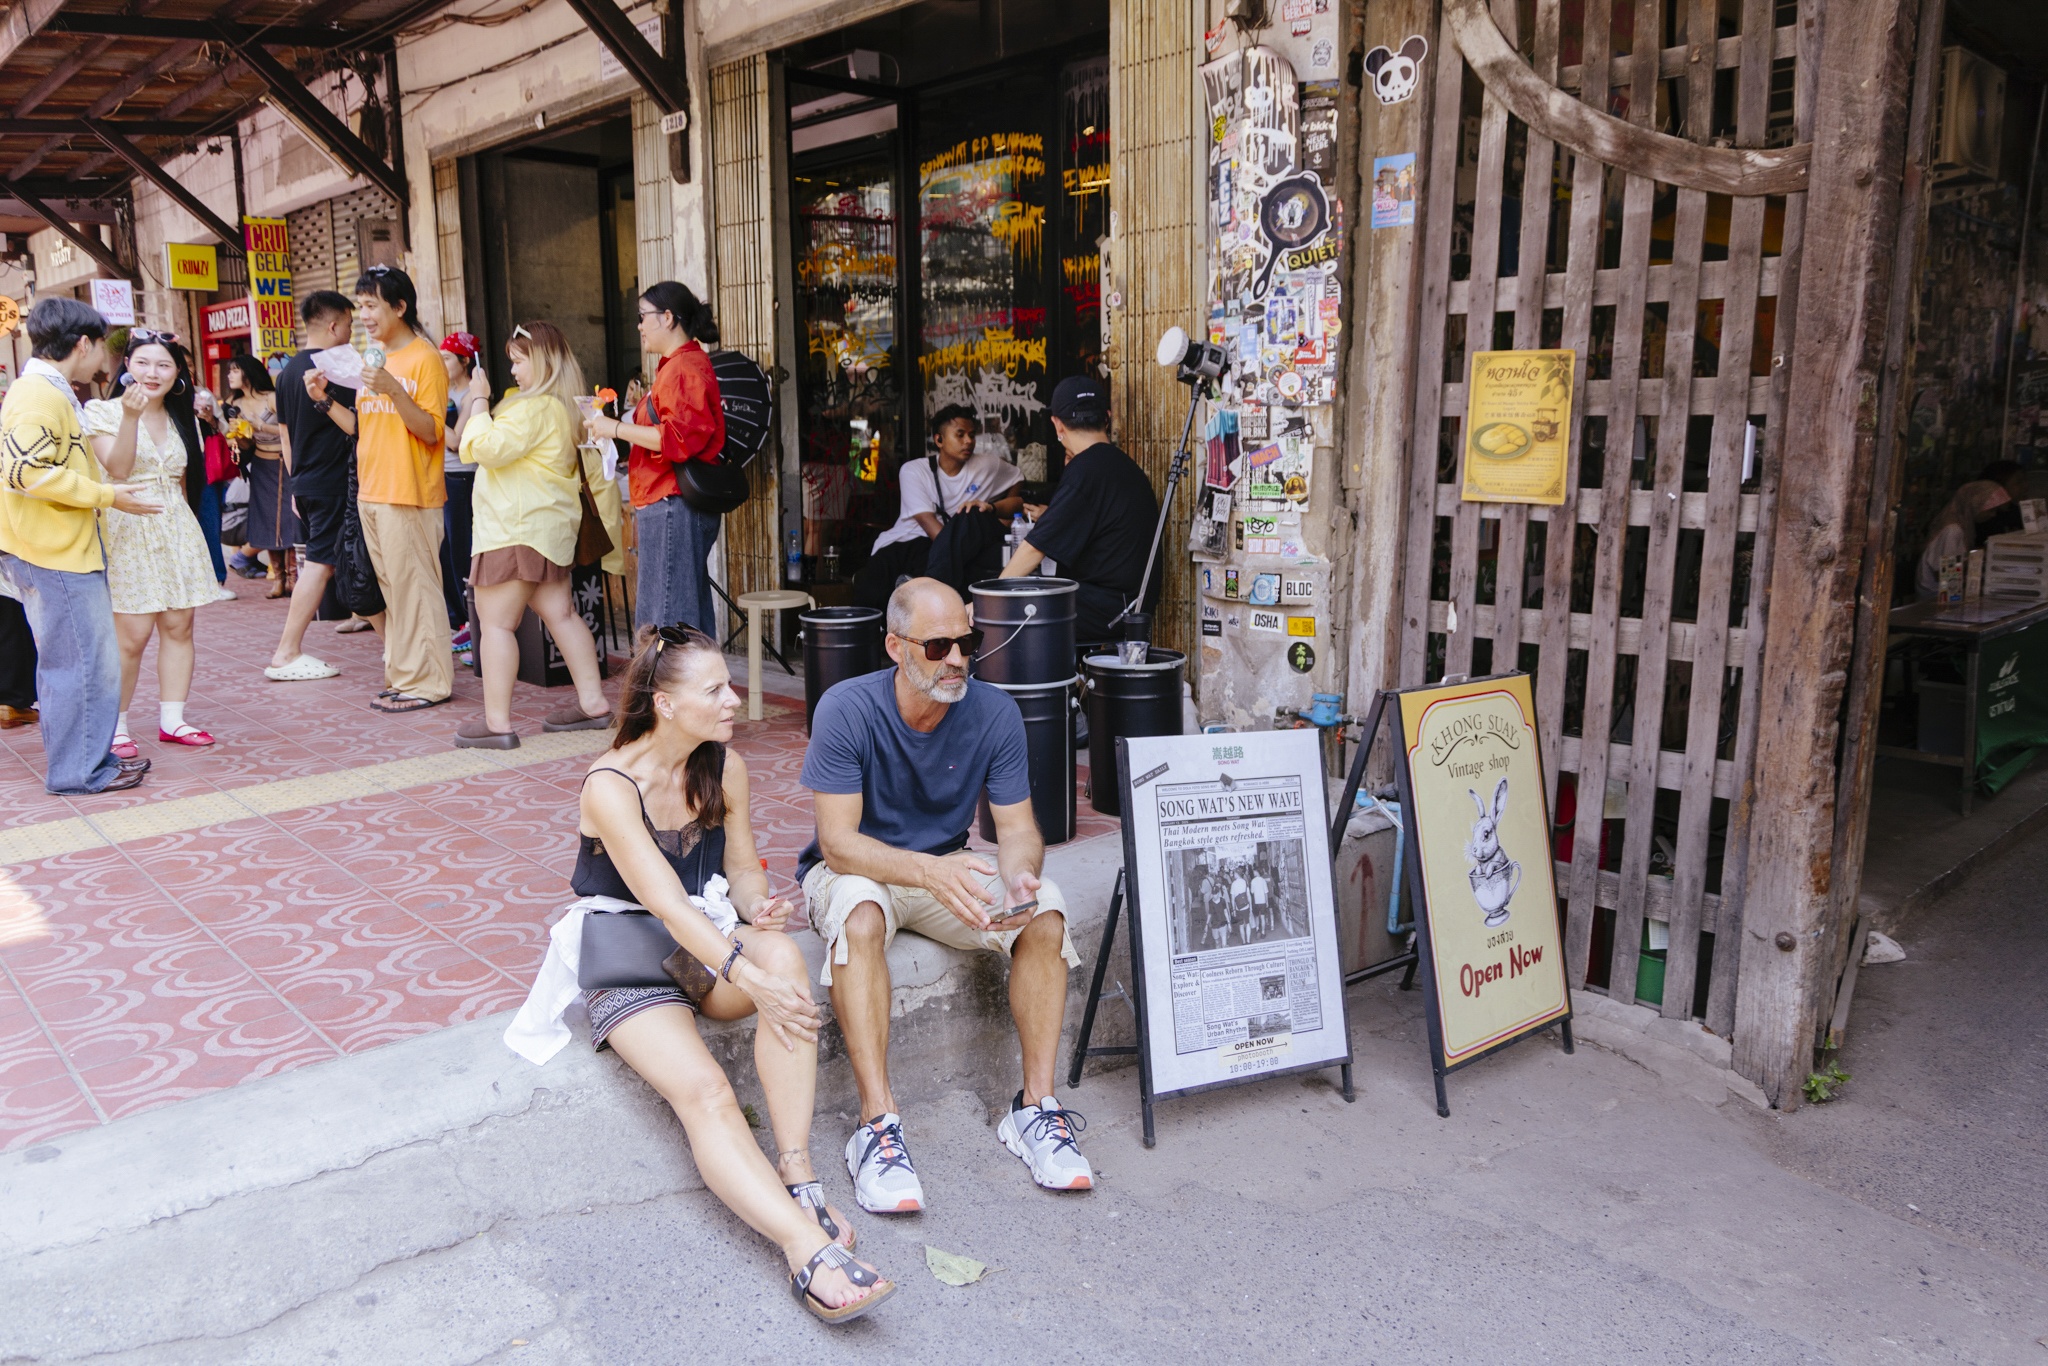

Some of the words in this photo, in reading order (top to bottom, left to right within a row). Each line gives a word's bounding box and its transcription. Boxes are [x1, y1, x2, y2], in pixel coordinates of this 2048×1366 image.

[665, 114, 683, 131] 1218
[1309, 140, 1329, 153] LIEBE
[256, 278, 292, 296] WE
[208, 311, 227, 333] MAD
[227, 306, 250, 329] PIZZA
[1250, 445, 1279, 467] MACH
[1287, 582, 1312, 596] BLOC
[1254, 613, 1279, 630] OSHA
[1431, 714, 1482, 756] KHONG
[1488, 714, 1518, 741] SUAY
[1447, 761, 1484, 779] Vintage
[1489, 753, 1510, 772] shop
[1160, 799, 1195, 818] SONG
[1198, 796, 1235, 815] WAT'S
[1238, 793, 1265, 811] NEW
[1268, 791, 1301, 808] WAVE
[1163, 826, 1180, 836] Thai
[1182, 824, 1209, 835] Modern
[1211, 823, 1231, 832] meets
[1232, 820, 1250, 831] Song
[1251, 818, 1266, 828] Wat.
[1164, 837, 1195, 848] Bangkok
[1197, 834, 1213, 845] style
[1215, 834, 1229, 844] gets
[1230, 830, 1265, 843] refreshed.
[1202, 970, 1224, 978] Coolness
[1225, 967, 1244, 975] Reborn
[1244, 963, 1265, 972] Through
[1266, 961, 1285, 969] Culture
[1460, 962, 1503, 998] Open
[1509, 944, 1544, 979] Now
[1173, 981, 1194, 990] Explore
[1174, 990, 1197, 998] Discover
[1207, 1022, 1221, 1031] Song
[1222, 1020, 1238, 1028] Wat's
[1207, 1030, 1224, 1038] Urban
[1225, 1026, 1247, 1035] Rhythm
[1234, 1041, 1255, 1051] OPEN
[1256, 1037, 1275, 1047] NOW
[1237, 1049, 1274, 1061] photobooth
